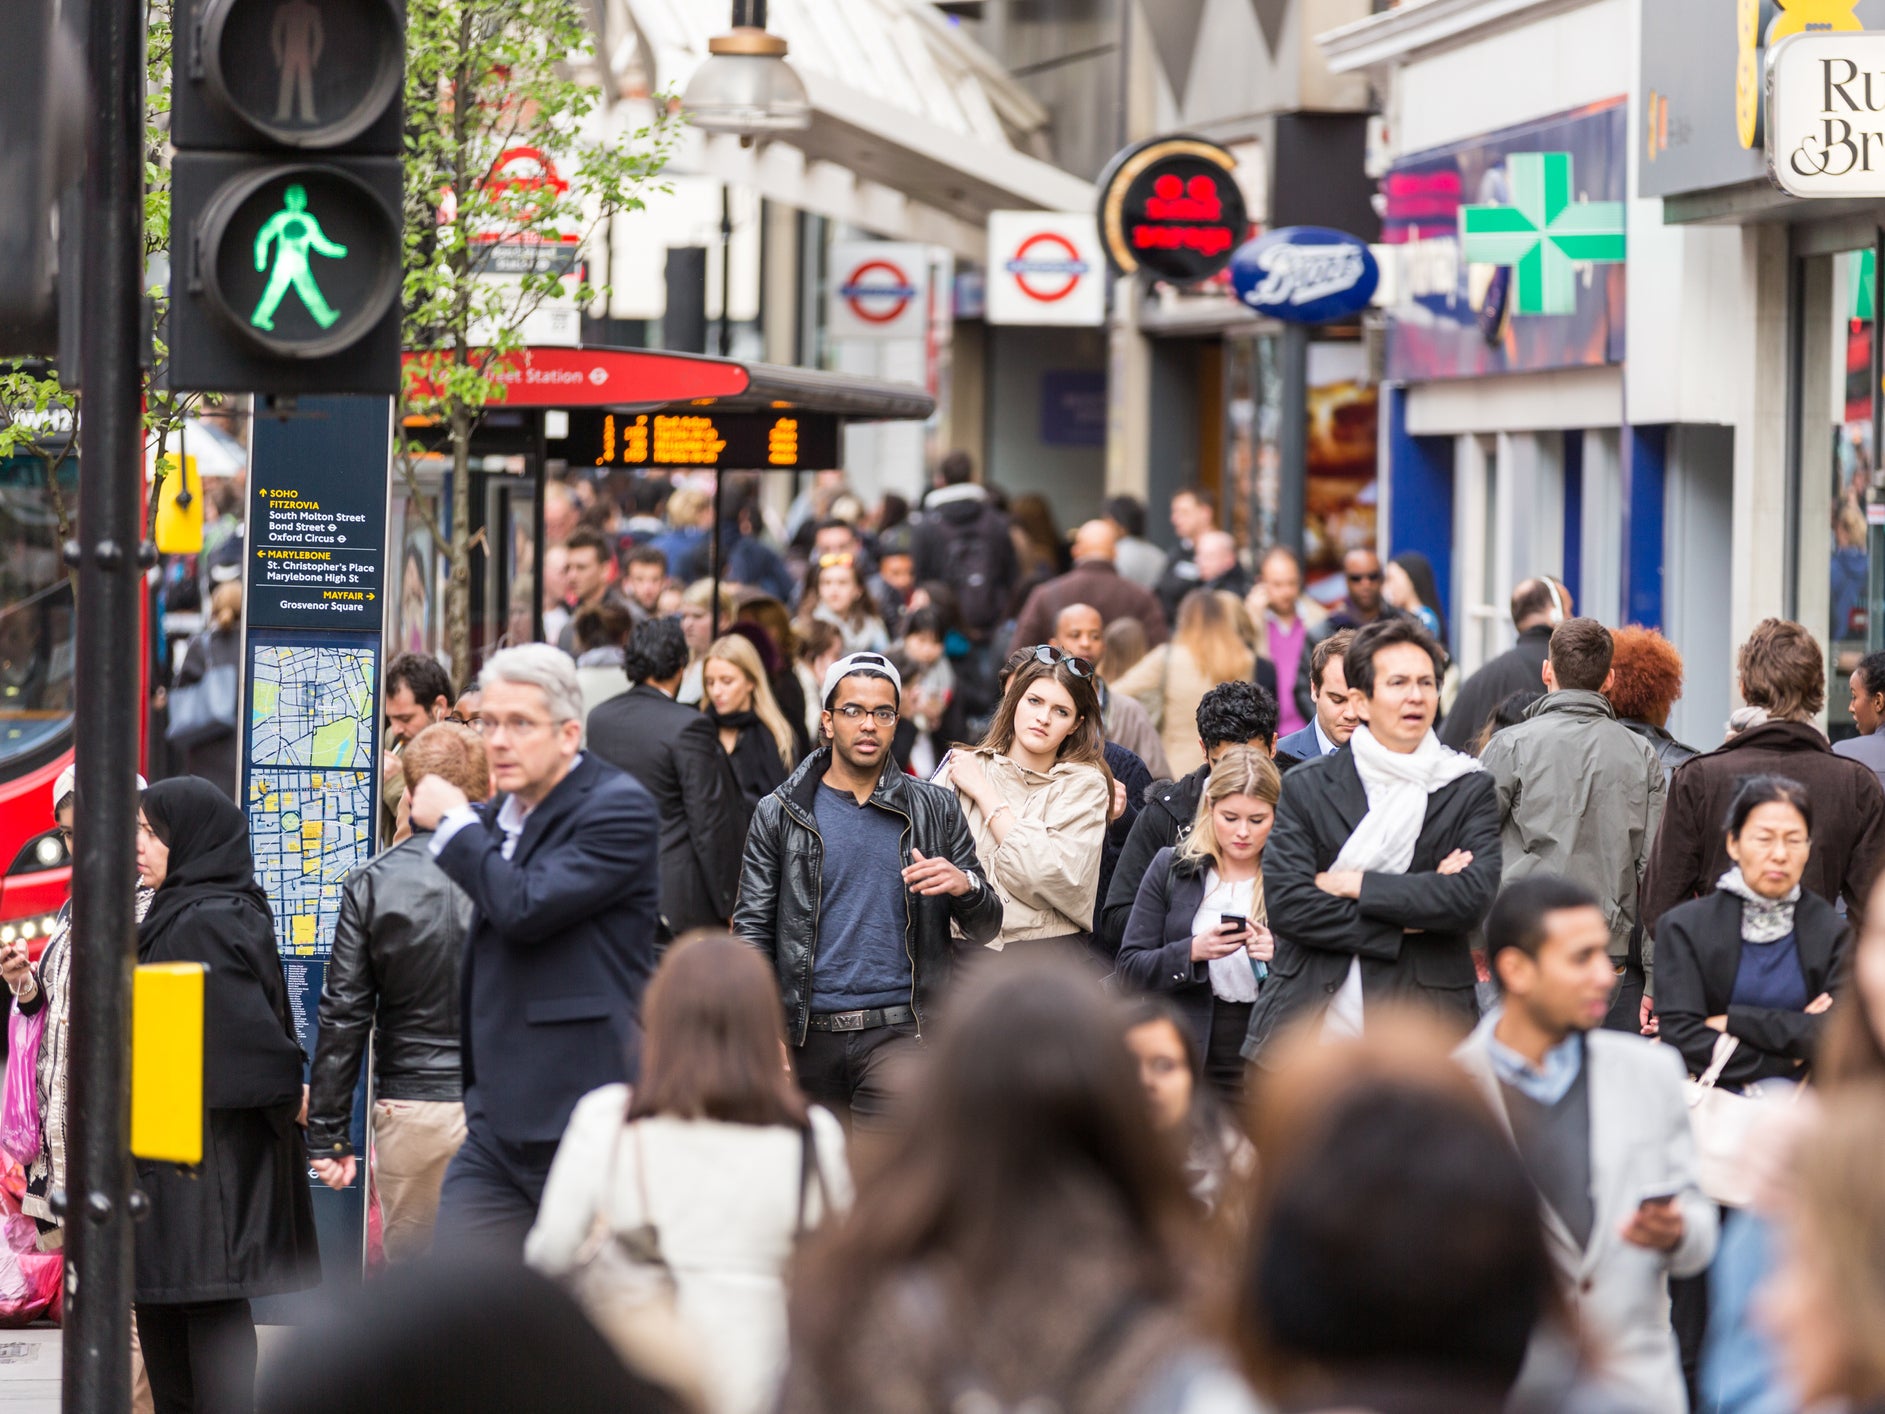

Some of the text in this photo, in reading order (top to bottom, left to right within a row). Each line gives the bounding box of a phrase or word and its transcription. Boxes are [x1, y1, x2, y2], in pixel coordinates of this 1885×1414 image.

[526, 369, 583, 384] Station
[270, 490, 298, 498] SOHO
[270, 501, 319, 510] FITZROVIA
[270, 511, 366, 522] South Molton Street
[269, 522, 325, 532] Bond Street
[269, 533, 334, 543] Oxford Circus
[268, 551, 331, 560] MARYLEBONE
[268, 561, 374, 572] St. Christopher's Place
[267, 572, 359, 584] Marylebone High St
[324, 592, 364, 600] MAYFAIR
[280, 600, 364, 612] Grosvenor Square
